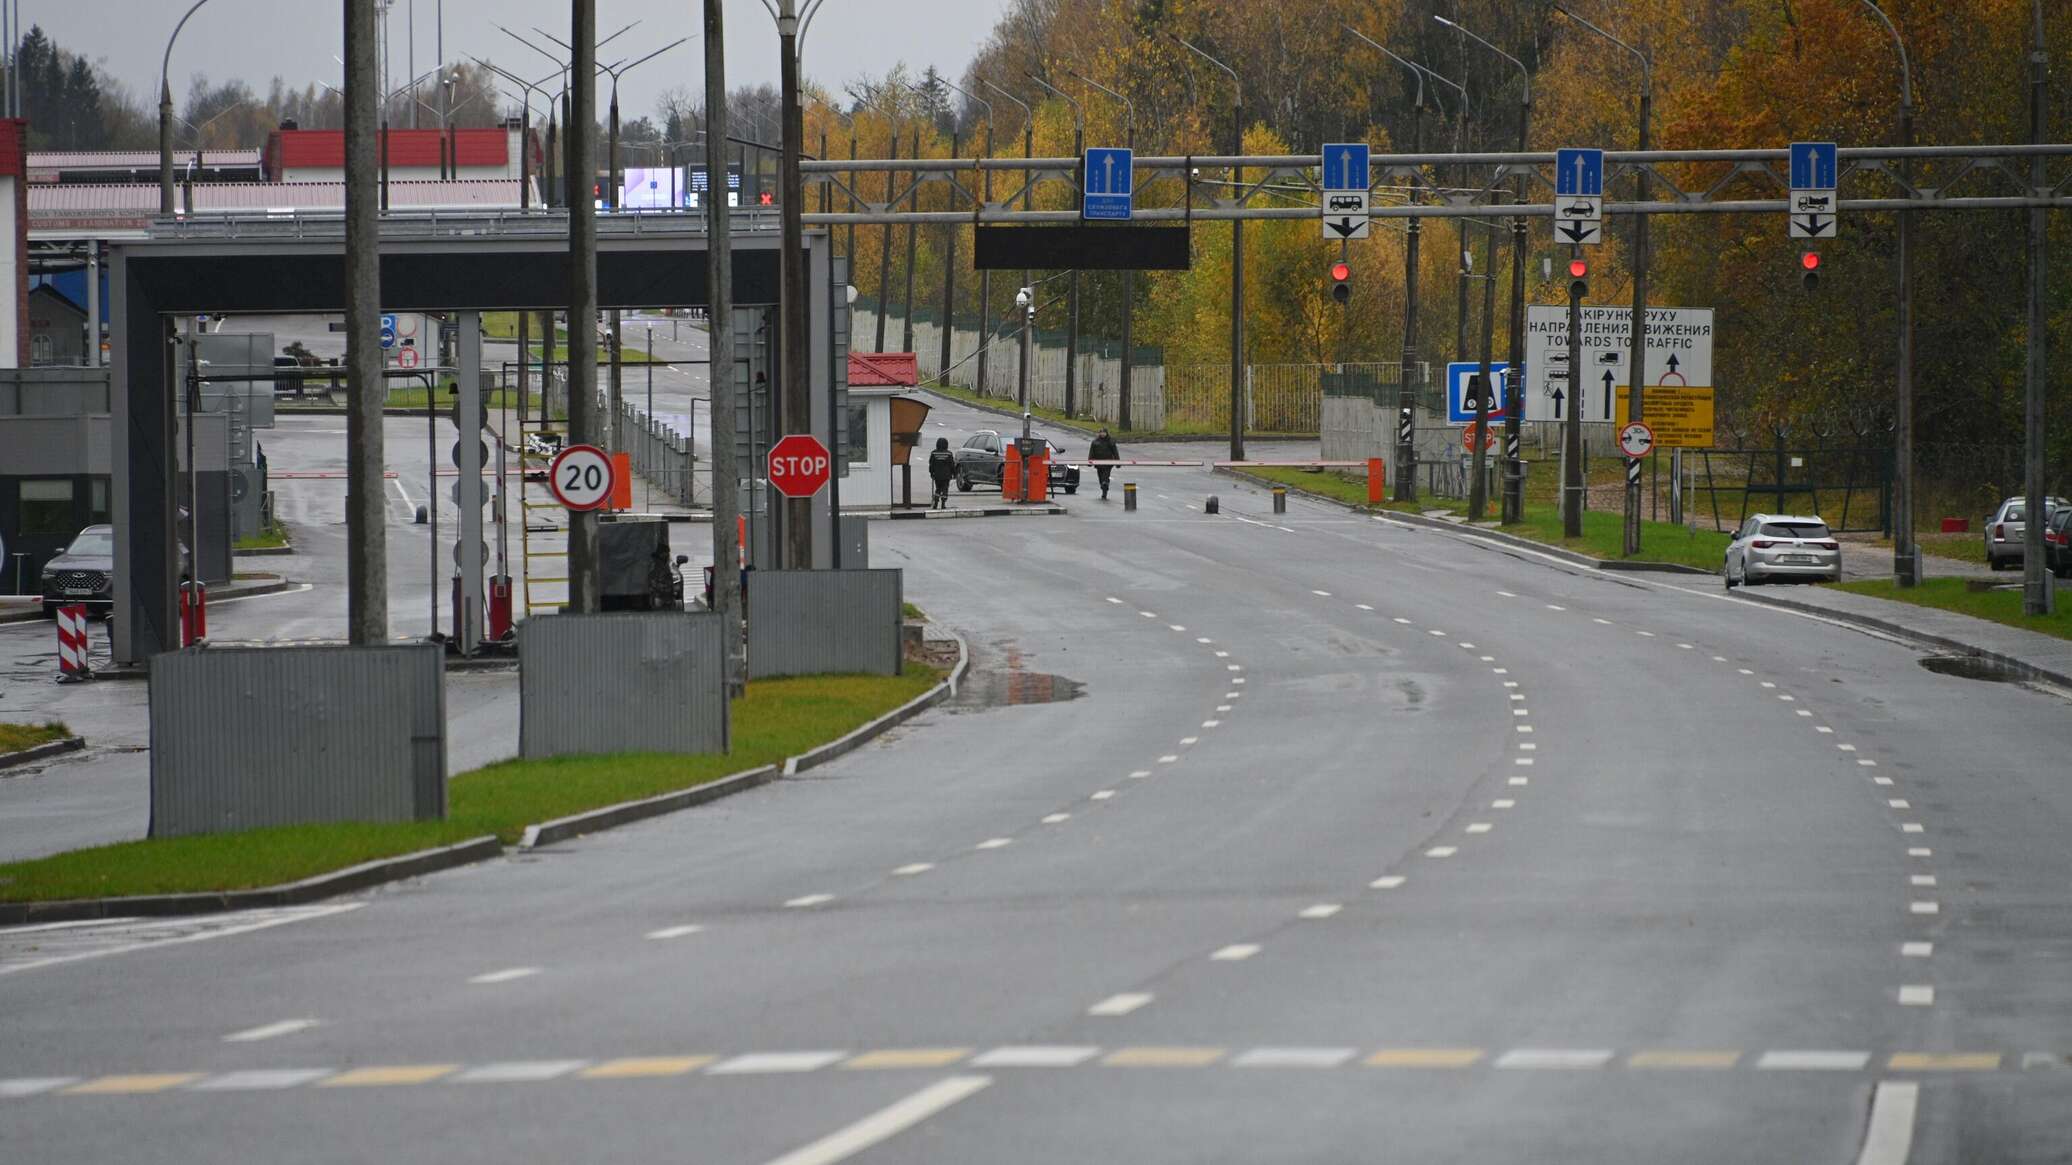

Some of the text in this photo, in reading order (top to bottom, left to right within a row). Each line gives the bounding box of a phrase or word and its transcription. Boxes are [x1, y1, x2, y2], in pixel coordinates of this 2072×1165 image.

[1529, 322, 1711, 336] НАПРАЛЕНИЯ ВИЖЕНИЯ
[1646, 337, 1693, 349] RAFFIC
[772, 456, 827, 477] STOP
[564, 464, 601, 491] 20
